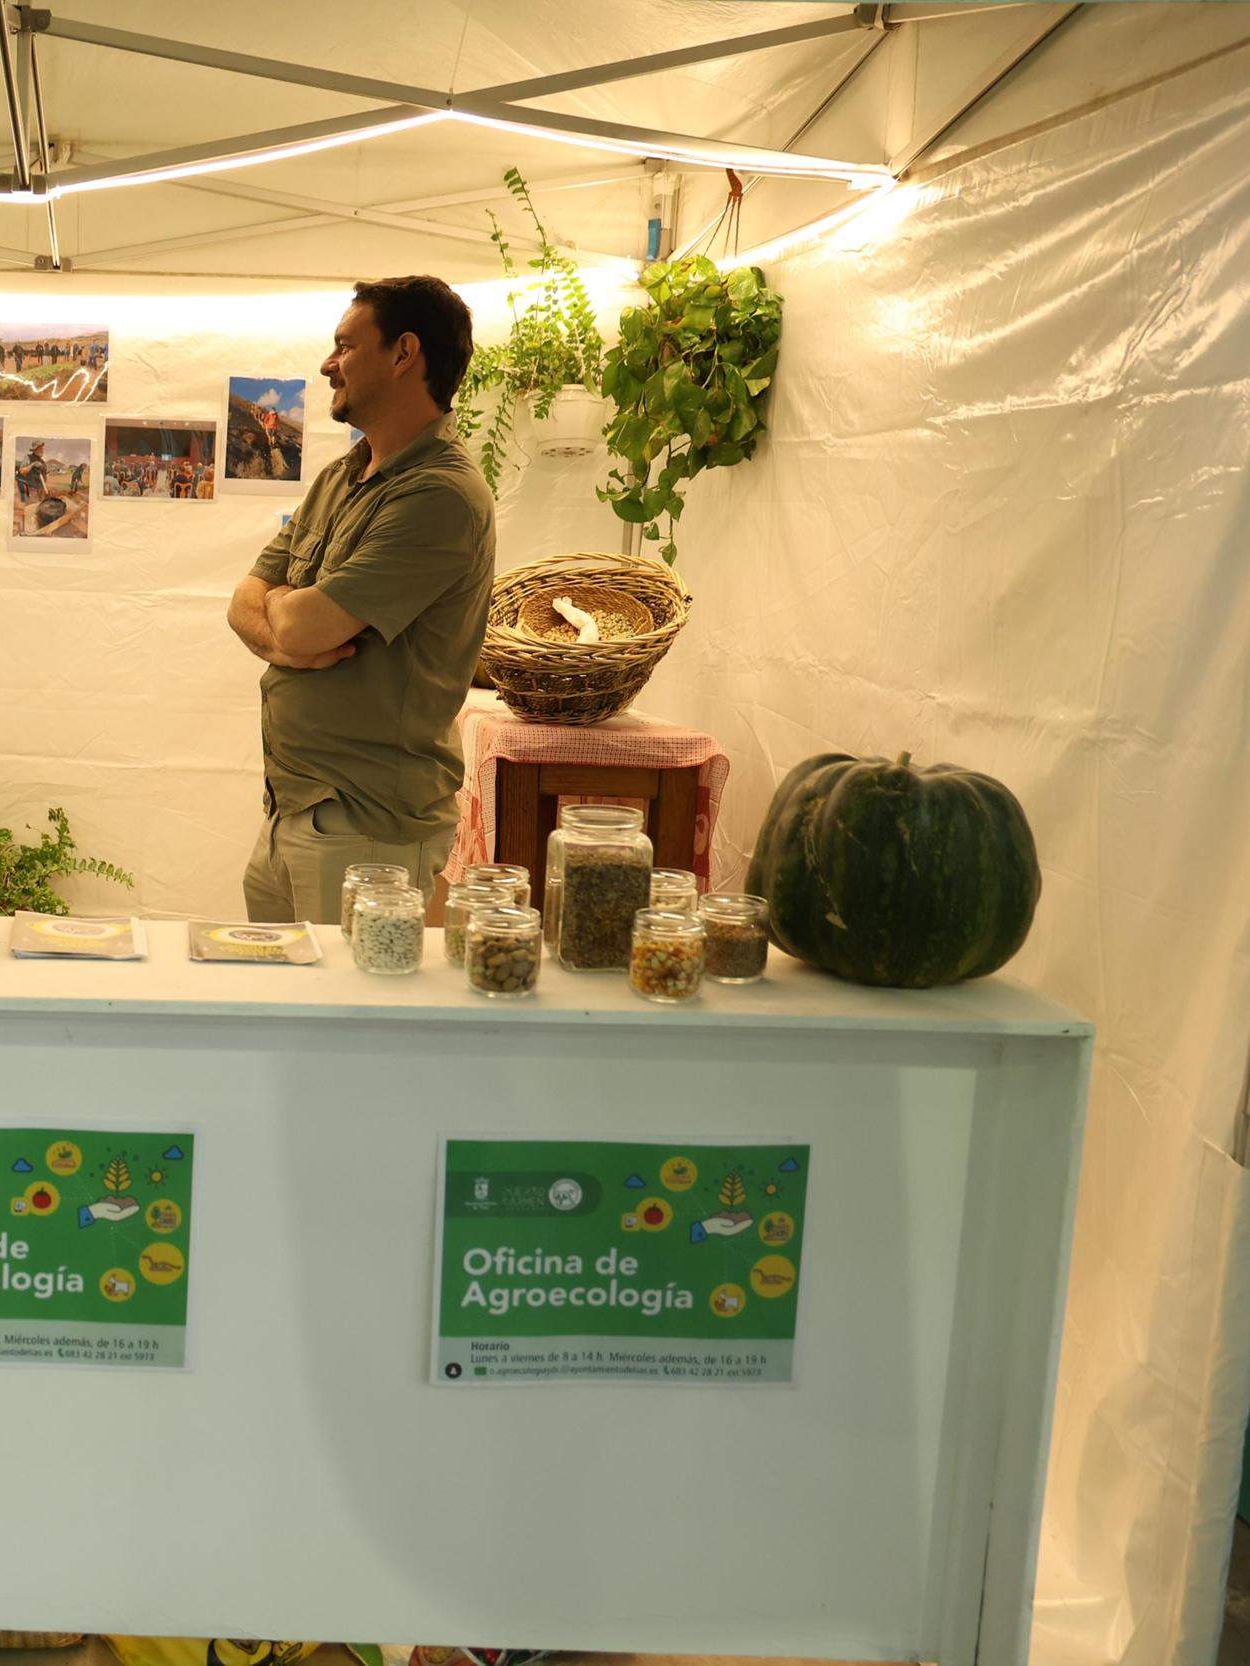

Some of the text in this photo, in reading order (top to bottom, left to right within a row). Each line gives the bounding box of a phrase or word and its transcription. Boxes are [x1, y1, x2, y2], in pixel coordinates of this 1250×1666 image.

[463, 1246, 639, 1276] Oficina de
[460, 1279, 694, 1316] Agroecología
[4, 1334, 50, 1346] Miércoles
[96, 1338, 110, 1349] de
[113, 1339, 126, 1350] 16
[128, 1341, 134, 1350] a
[138, 1340, 150, 1350] 19
[470, 1341, 510, 1351] Horario
[470, 1353, 498, 1364] Lunes
[502, 1355, 508, 1363] a
[511, 1353, 545, 1363] viernes
[547, 1352, 560, 1363] de
[563, 1352, 569, 1361] 8
[572, 1354, 578, 1362] a
[582, 1352, 593, 1362] 14
[608, 1351, 655, 1363] Miércoles
[704, 1354, 717, 1365] de
[721, 1354, 733, 1365] 16
[735, 1356, 742, 1365] a
[745, 1355, 758, 1366] 19
